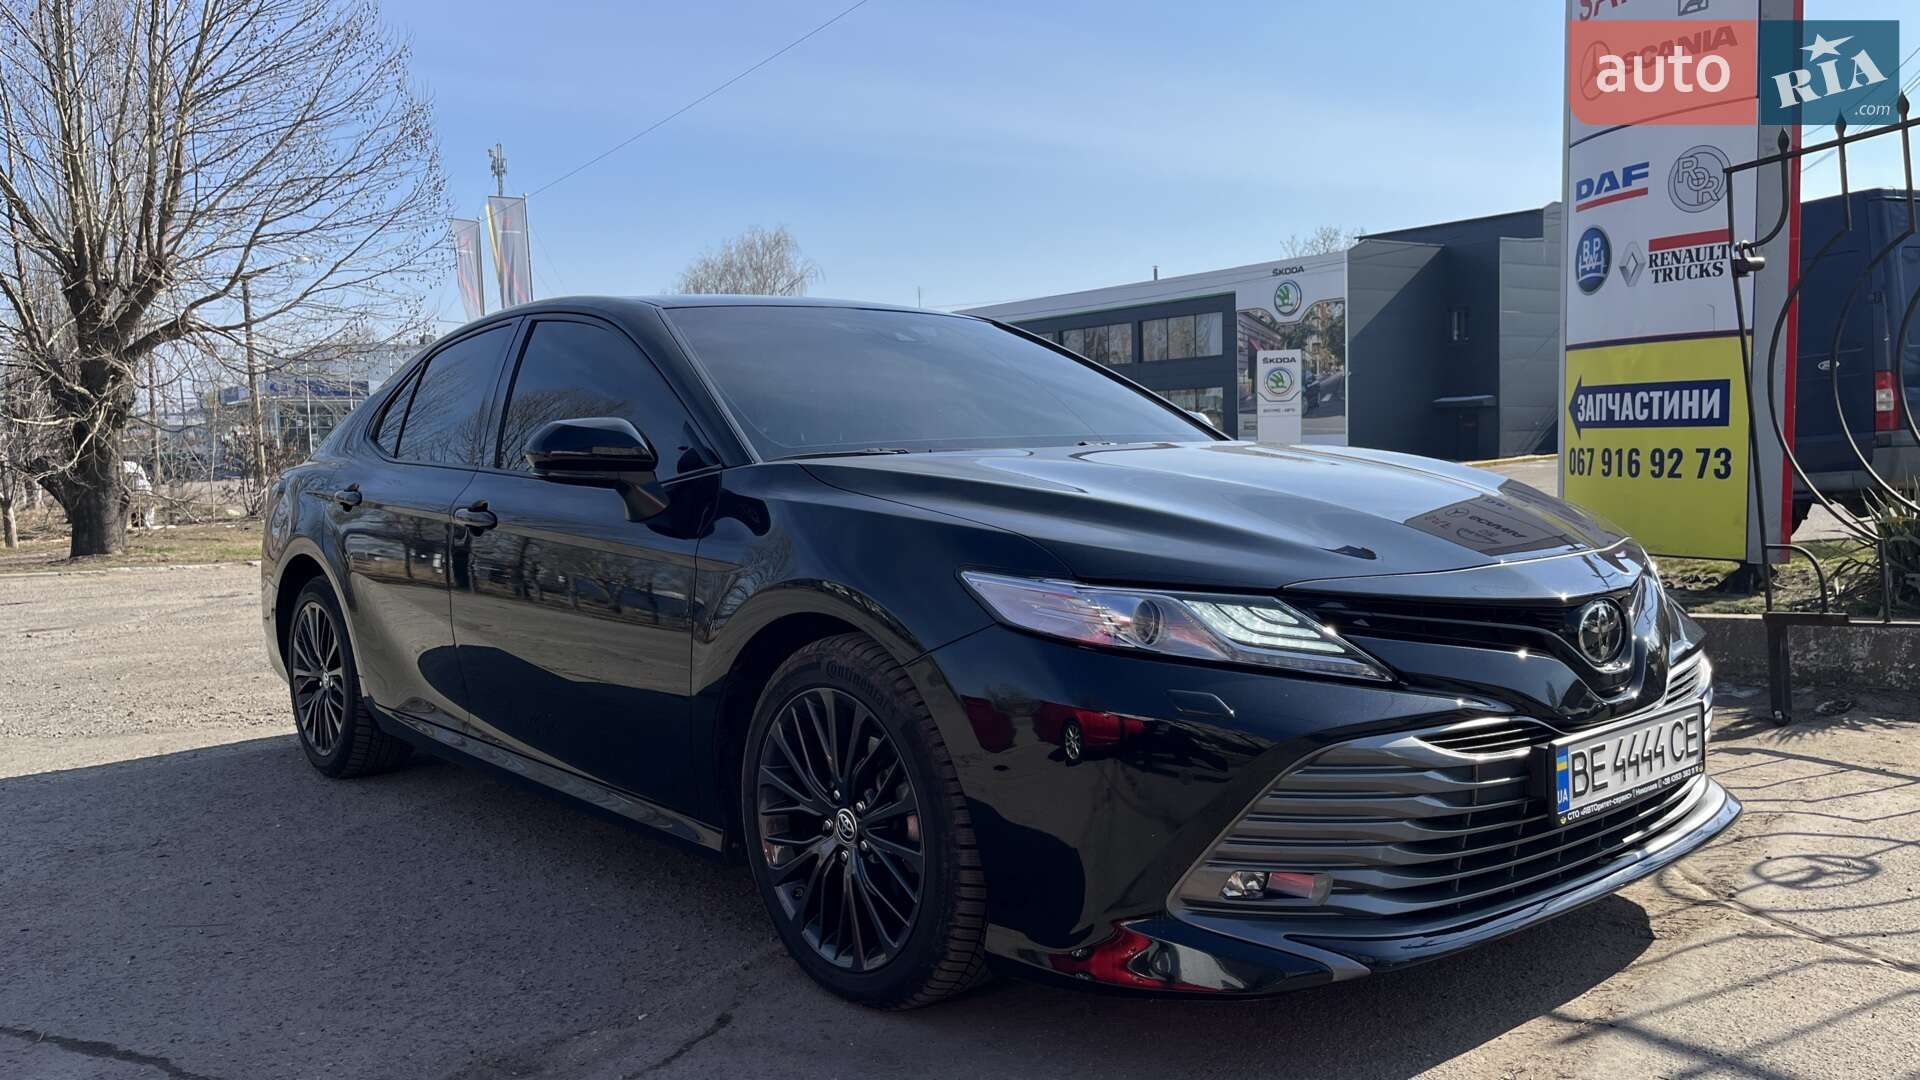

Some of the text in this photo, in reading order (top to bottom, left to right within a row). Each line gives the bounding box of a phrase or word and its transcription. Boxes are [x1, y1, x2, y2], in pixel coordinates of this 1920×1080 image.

[1576, 162, 1650, 201] DAF
[1648, 243, 1730, 269] RENAULT
[1651, 261, 1725, 284] TRUCKS
[1577, 388, 1721, 422] ЗАПЧАСТИНИ
[1569, 448, 1732, 479] 067 916 92 73
[1571, 714, 1698, 798] BE 4444 CE
[1557, 788, 1569, 804] UA
[1567, 810, 1580, 820] СТО
